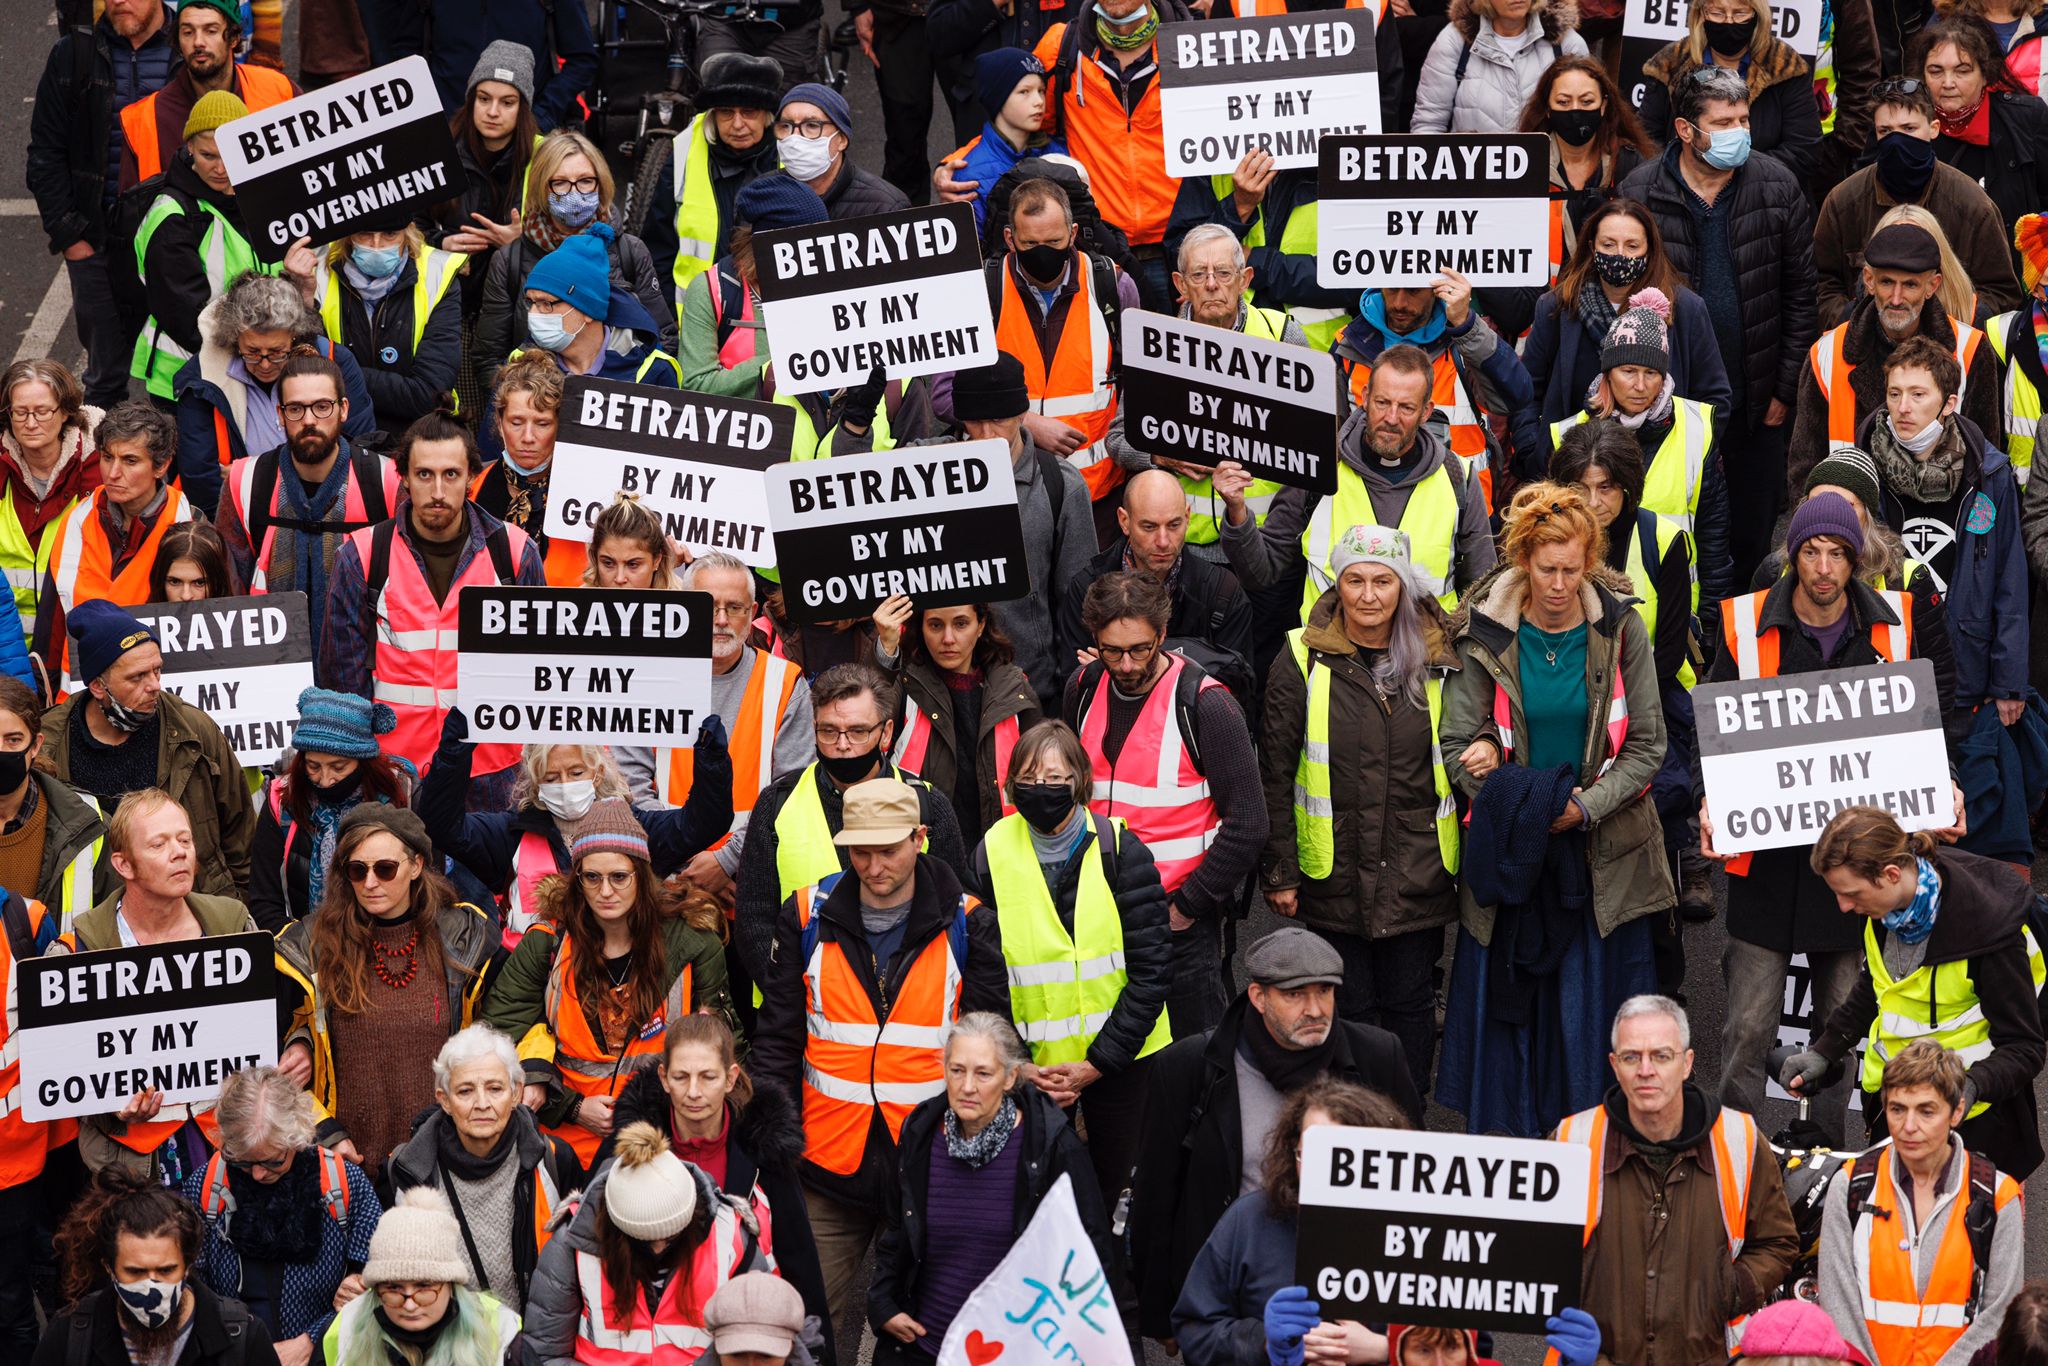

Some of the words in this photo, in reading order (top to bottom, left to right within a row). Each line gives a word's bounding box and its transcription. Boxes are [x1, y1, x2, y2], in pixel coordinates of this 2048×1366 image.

[1176, 21, 1355, 68] BETRAYED
[238, 77, 413, 164] BETRAYED
[1227, 93, 1261, 120] BY
[1274, 89, 1312, 117] MY
[301, 161, 336, 194] BY
[346, 144, 384, 179] MY
[1338, 145, 1528, 180] BETRAYED
[268, 161, 446, 244] GOVERNMENT
[1387, 210, 1423, 235] BY
[1435, 210, 1478, 234] MY
[772, 217, 957, 279] BETRAYED
[1332, 248, 1532, 275] GOVERNMENT
[831, 300, 866, 331] BY
[880, 292, 918, 324] MY
[788, 325, 978, 380] GOVERNMENT
[1142, 325, 1314, 393] BETRAYED
[579, 389, 772, 450] BETRAYED
[1188, 391, 1221, 419] BY
[1232, 401, 1270, 430] MY
[1141, 415, 1319, 477] GOVERNMENT
[621, 464, 660, 494] BY
[670, 471, 715, 502] MY
[789, 457, 988, 513] BETRAYED
[561, 498, 765, 552] GONMENT
[850, 531, 888, 560] BY
[902, 524, 944, 554] MY
[802, 557, 1006, 606] GOVERNMENT
[136, 606, 288, 654] RAYED
[481, 599, 689, 638] BETRAYED
[198, 681, 241, 711] MY
[534, 666, 574, 691] BY
[587, 667, 634, 693] MY
[474, 703, 693, 734] GOVERNMENT
[1714, 674, 1915, 733] BETRAYED
[1776, 757, 1814, 788] BY
[1829, 750, 1871, 782] MY
[39, 947, 251, 1006] BETRAYED
[97, 1027, 137, 1058] BY
[151, 1020, 198, 1051] MY
[1329, 1146, 1559, 1202] BETRAYED
[1384, 1224, 1430, 1258] BY
[1442, 1229, 1496, 1263] MY
[1317, 1266, 1558, 1315] GOVERNMENT
